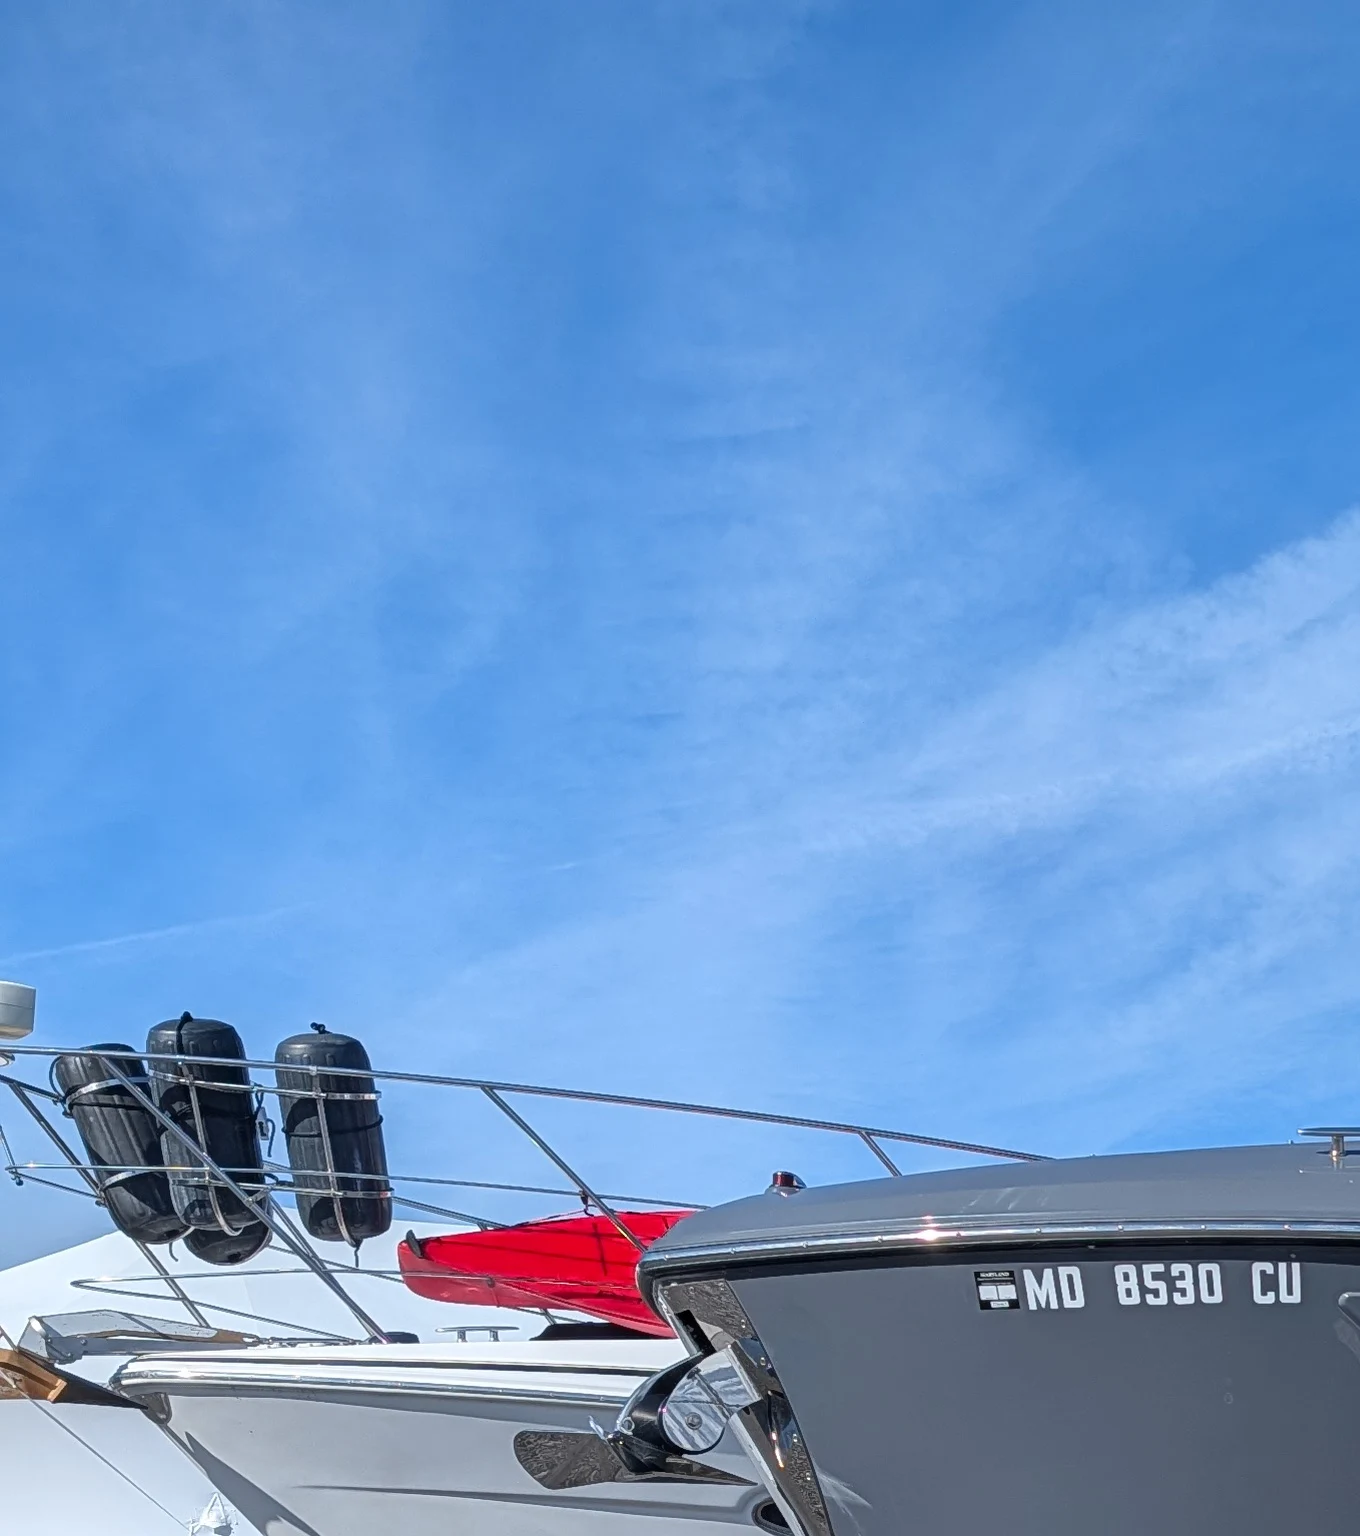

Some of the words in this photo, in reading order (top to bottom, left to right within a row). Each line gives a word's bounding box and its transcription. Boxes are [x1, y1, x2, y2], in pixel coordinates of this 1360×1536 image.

[1022, 1265, 1085, 1310] MD
[1114, 1262, 1224, 1306] 8530
[1251, 1261, 1301, 1304] CU
